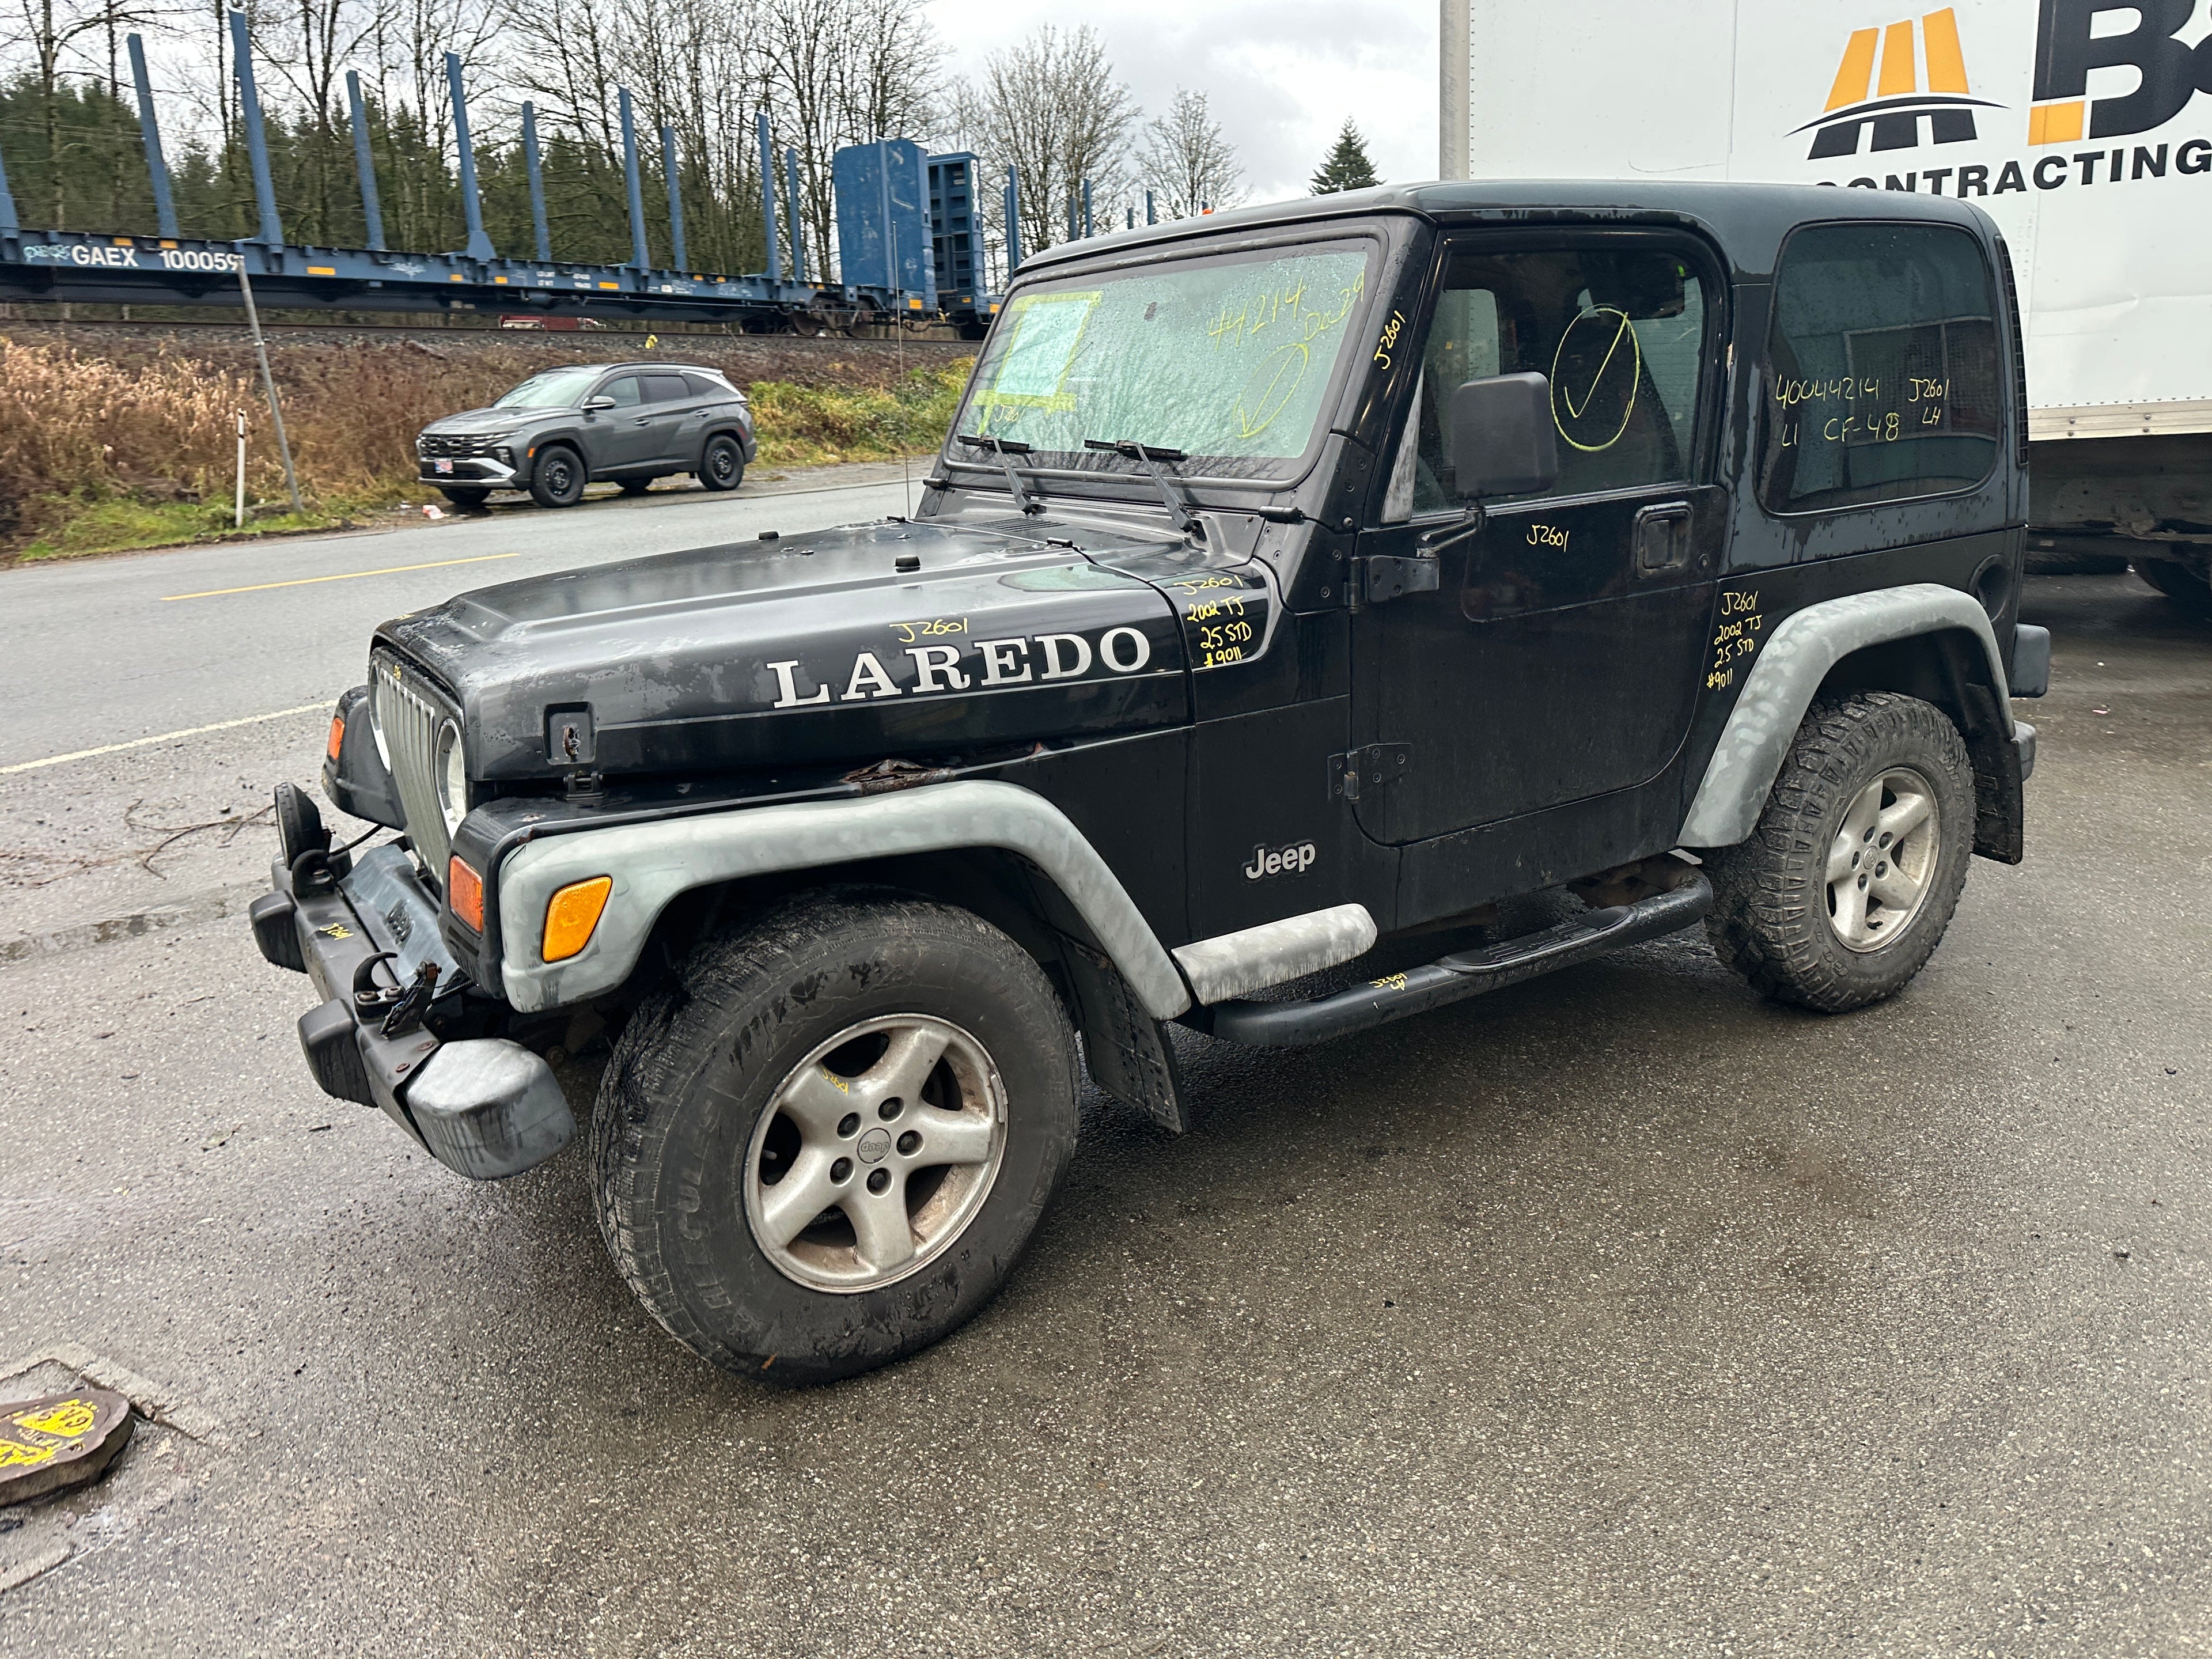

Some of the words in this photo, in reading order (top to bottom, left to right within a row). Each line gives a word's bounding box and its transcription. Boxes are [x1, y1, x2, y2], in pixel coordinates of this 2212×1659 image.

[1815, 139, 2212, 199] NTRACTING
[71, 245, 139, 267] GAEX
[1209, 276, 1307, 353] 44214
[1374, 309, 1406, 370] J2601
[1776, 373, 1880, 410] 40044214
[1908, 378, 1950, 402] J2601
[1526, 524, 1569, 553] J2601
[1173, 575, 1244, 596] J2601
[1187, 600, 1221, 623] 2002
[1220, 596, 1244, 616] TJ
[1721, 590, 1759, 615] J2601
[889, 618, 968, 643] J2601
[1225, 621, 1252, 642] STD
[1714, 621, 1742, 645] 2002
[1745, 614, 1763, 630] TJ
[766, 626, 1151, 709] LAREDO
[1714, 643, 1733, 668] 2.5
[1737, 638, 1754, 656] STD
[1706, 668, 1733, 691] #9011
[1245, 843, 1316, 879] Jeep
[1368, 972, 1408, 988] J2601
